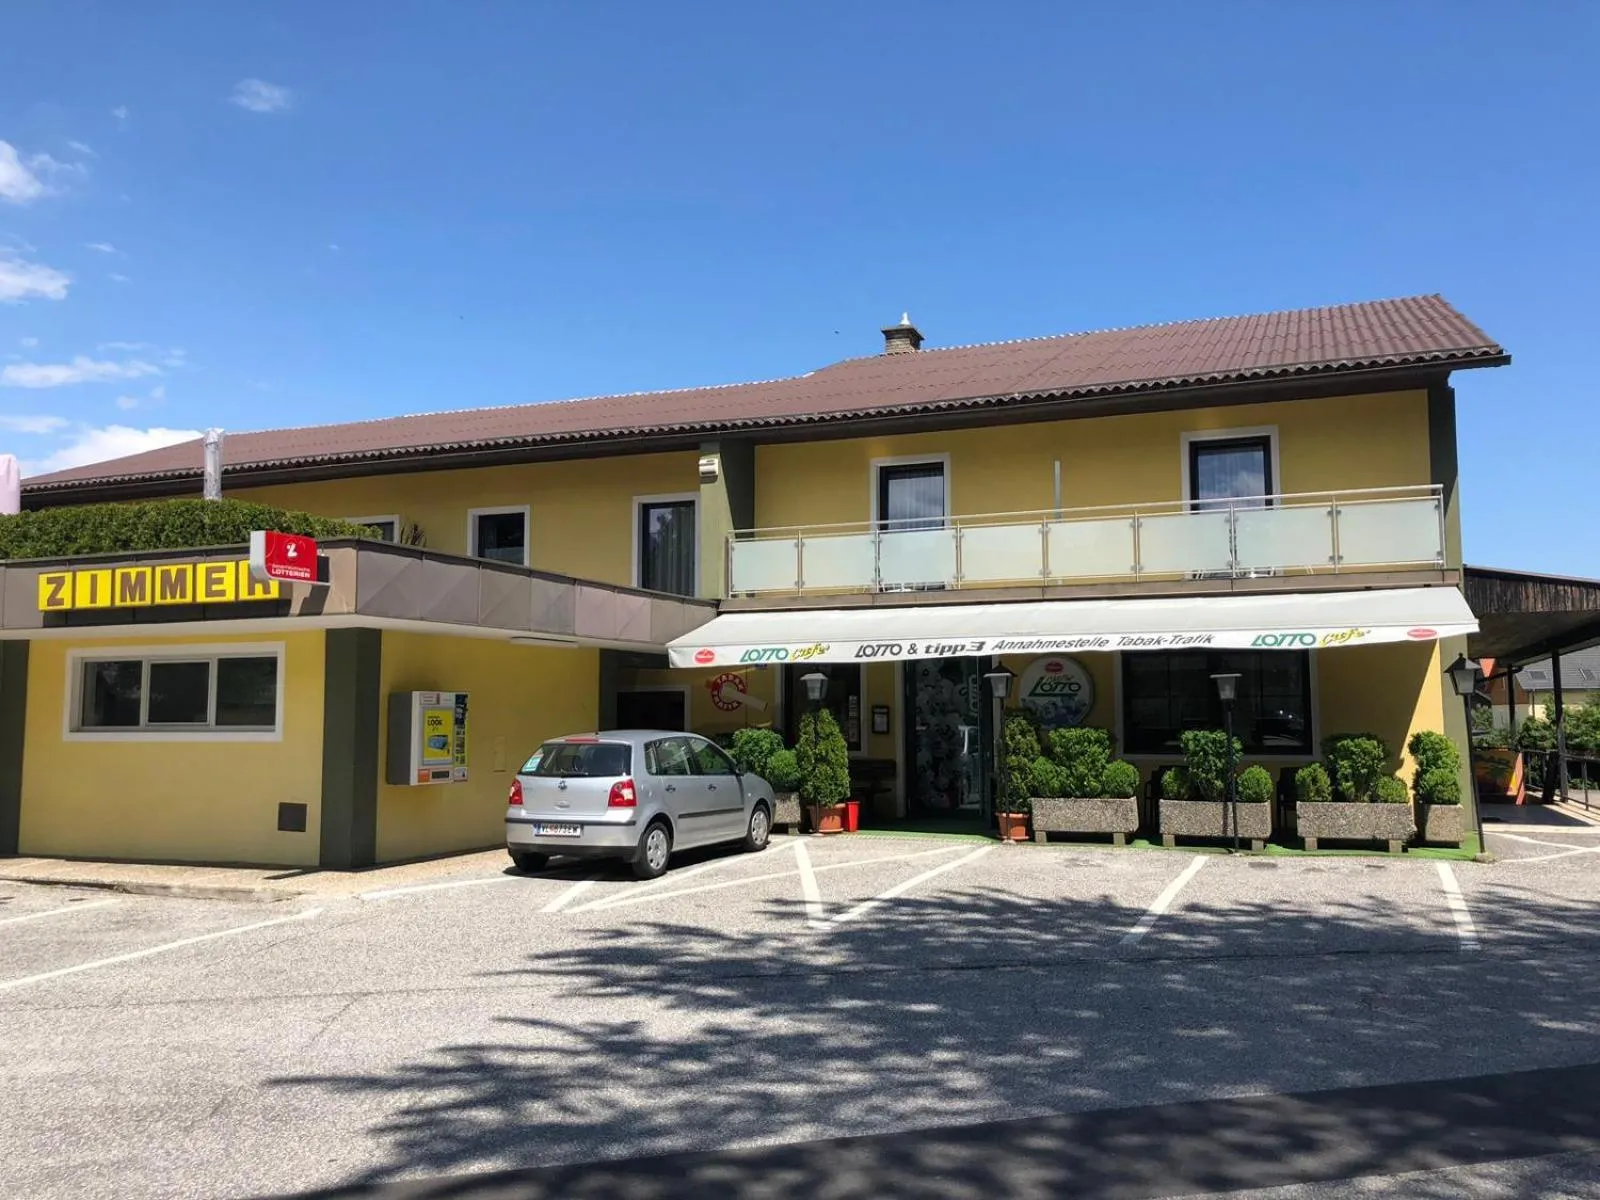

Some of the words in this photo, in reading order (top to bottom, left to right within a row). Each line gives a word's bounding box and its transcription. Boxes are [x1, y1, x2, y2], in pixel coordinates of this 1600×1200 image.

[854, 643, 903, 658] LOTTO
[907, 643, 918, 655] &
[925, 641, 986, 655] tipp3
[991, 637, 1110, 651] Annahmestelle
[1117, 634, 1216, 647] Tabak-Trafik
[1251, 632, 1317, 647] LOTTO
[739, 647, 789, 663] LOTTO
